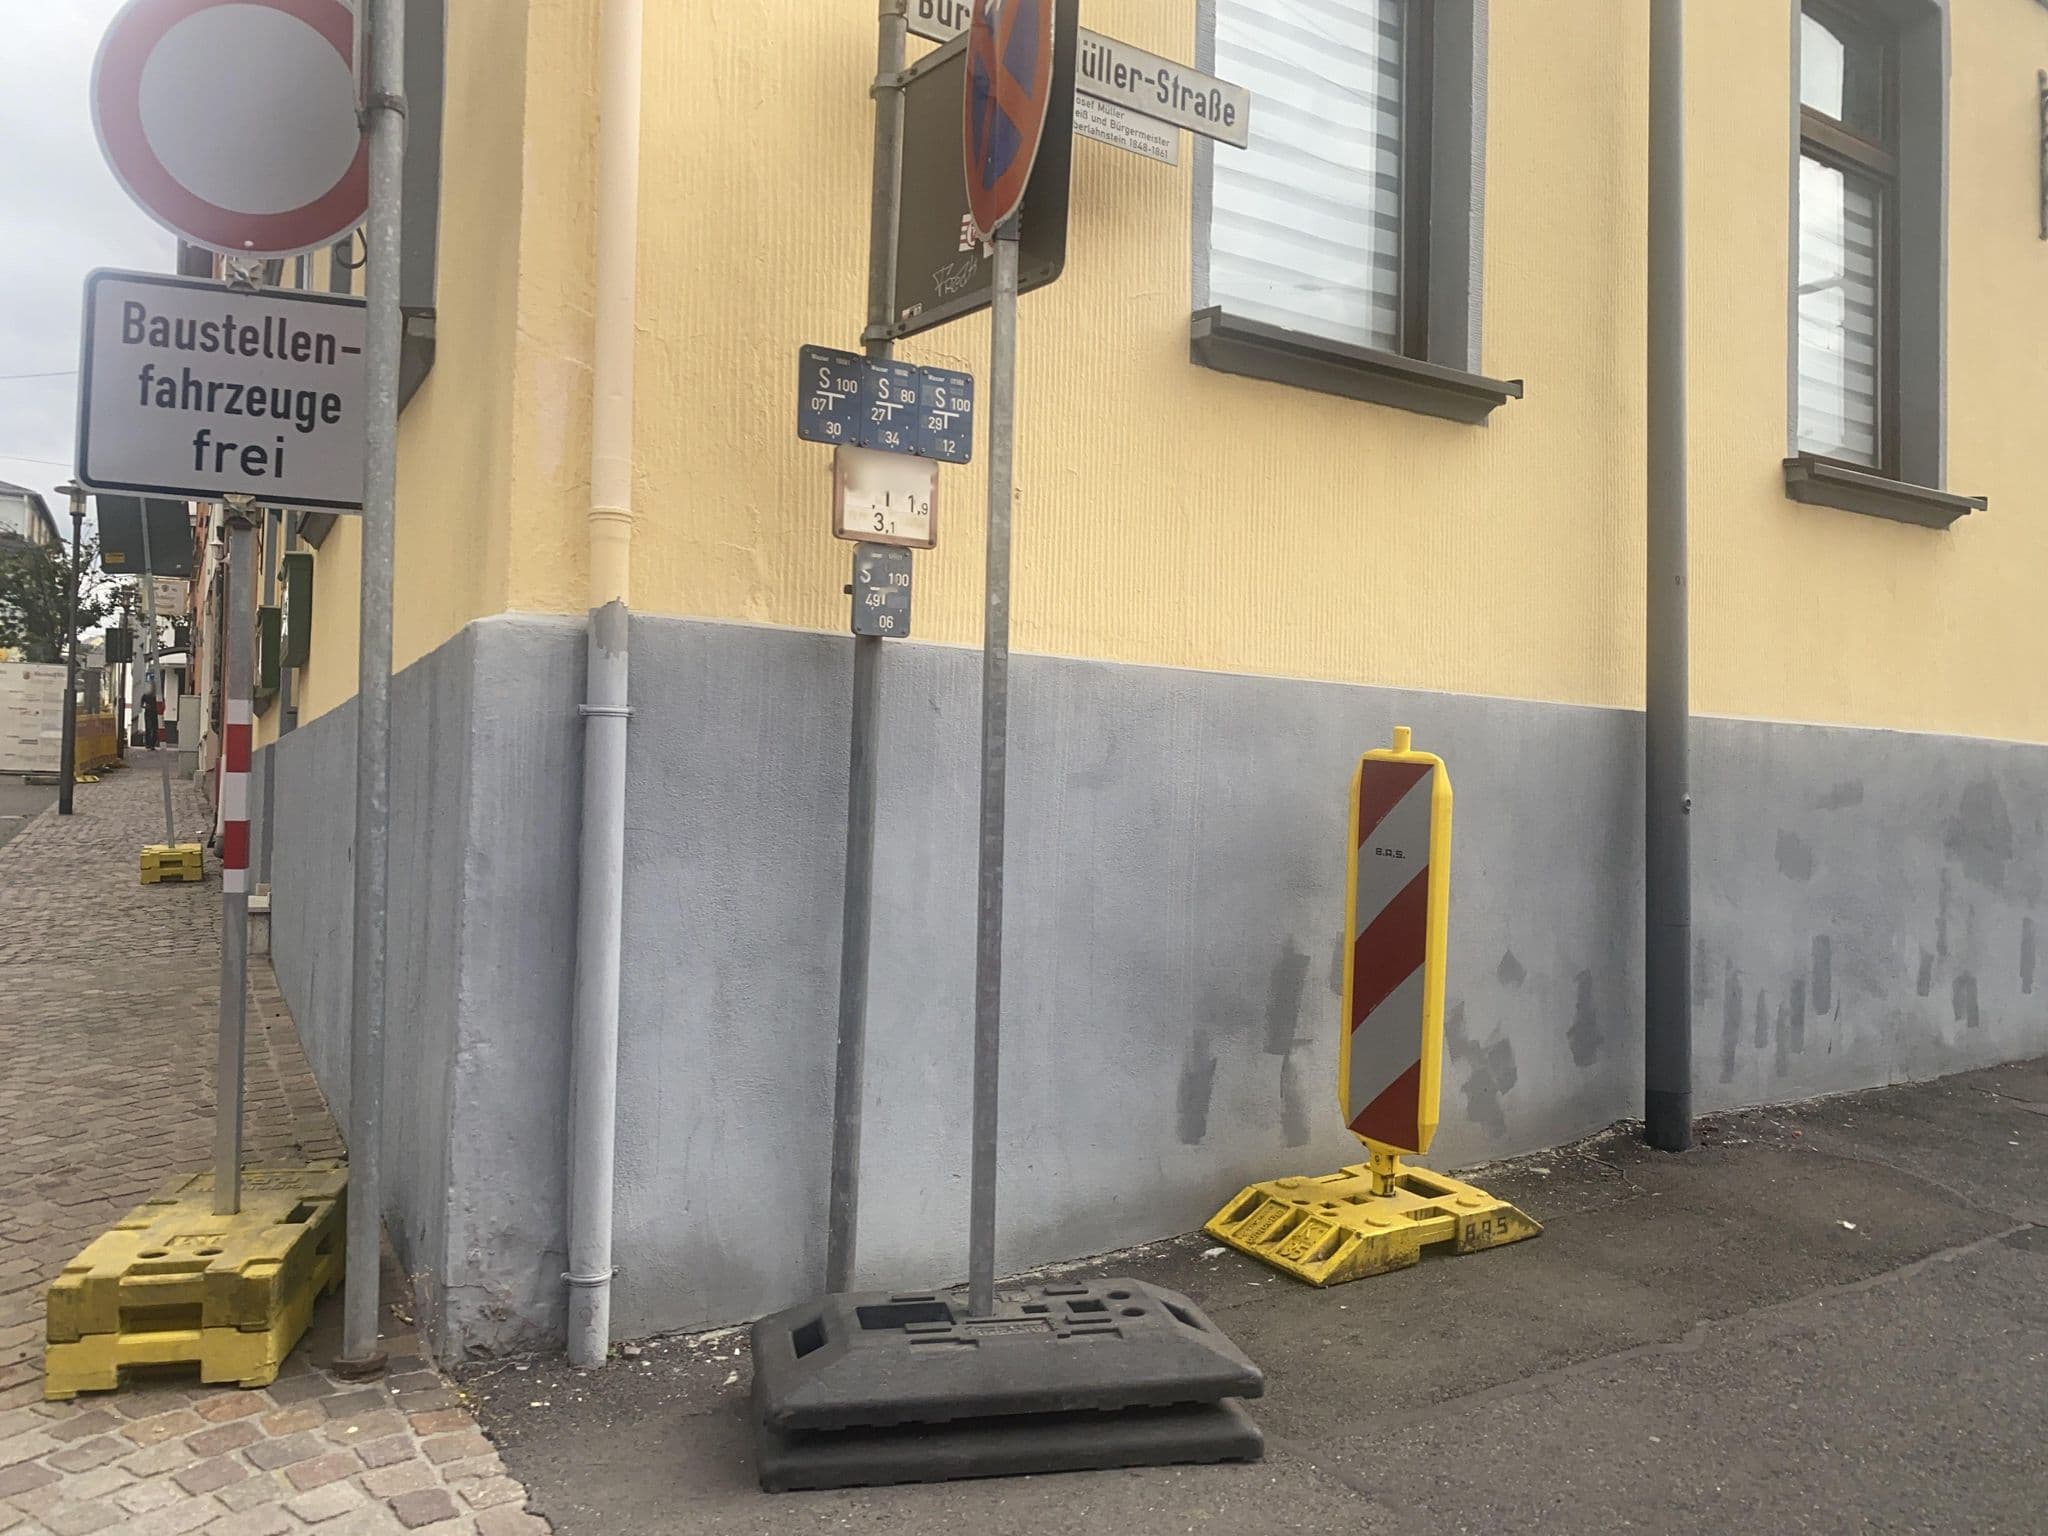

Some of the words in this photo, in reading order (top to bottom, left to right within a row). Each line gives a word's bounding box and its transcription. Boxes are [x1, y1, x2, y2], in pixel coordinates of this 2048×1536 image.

[1078, 39, 1236, 127] üller-Straße
[1076, 97, 1095, 109] osef
[1098, 103, 1125, 120] Müller
[1073, 121, 1126, 145] berlahnstein
[1129, 138, 1168, 159] 1848-1861
[1075, 109, 1088, 119] eiß
[1091, 114, 1107, 126] und
[1110, 120, 1171, 147] Bürgermeister
[121, 300, 362, 366] Baustellen-
[138, 363, 342, 434] fahrzeuge
[836, 377, 858, 394] 100
[900, 388, 916, 404] 80
[951, 397, 971, 412] 100
[192, 428, 285, 478] frei
[888, 572, 909, 587] 100
